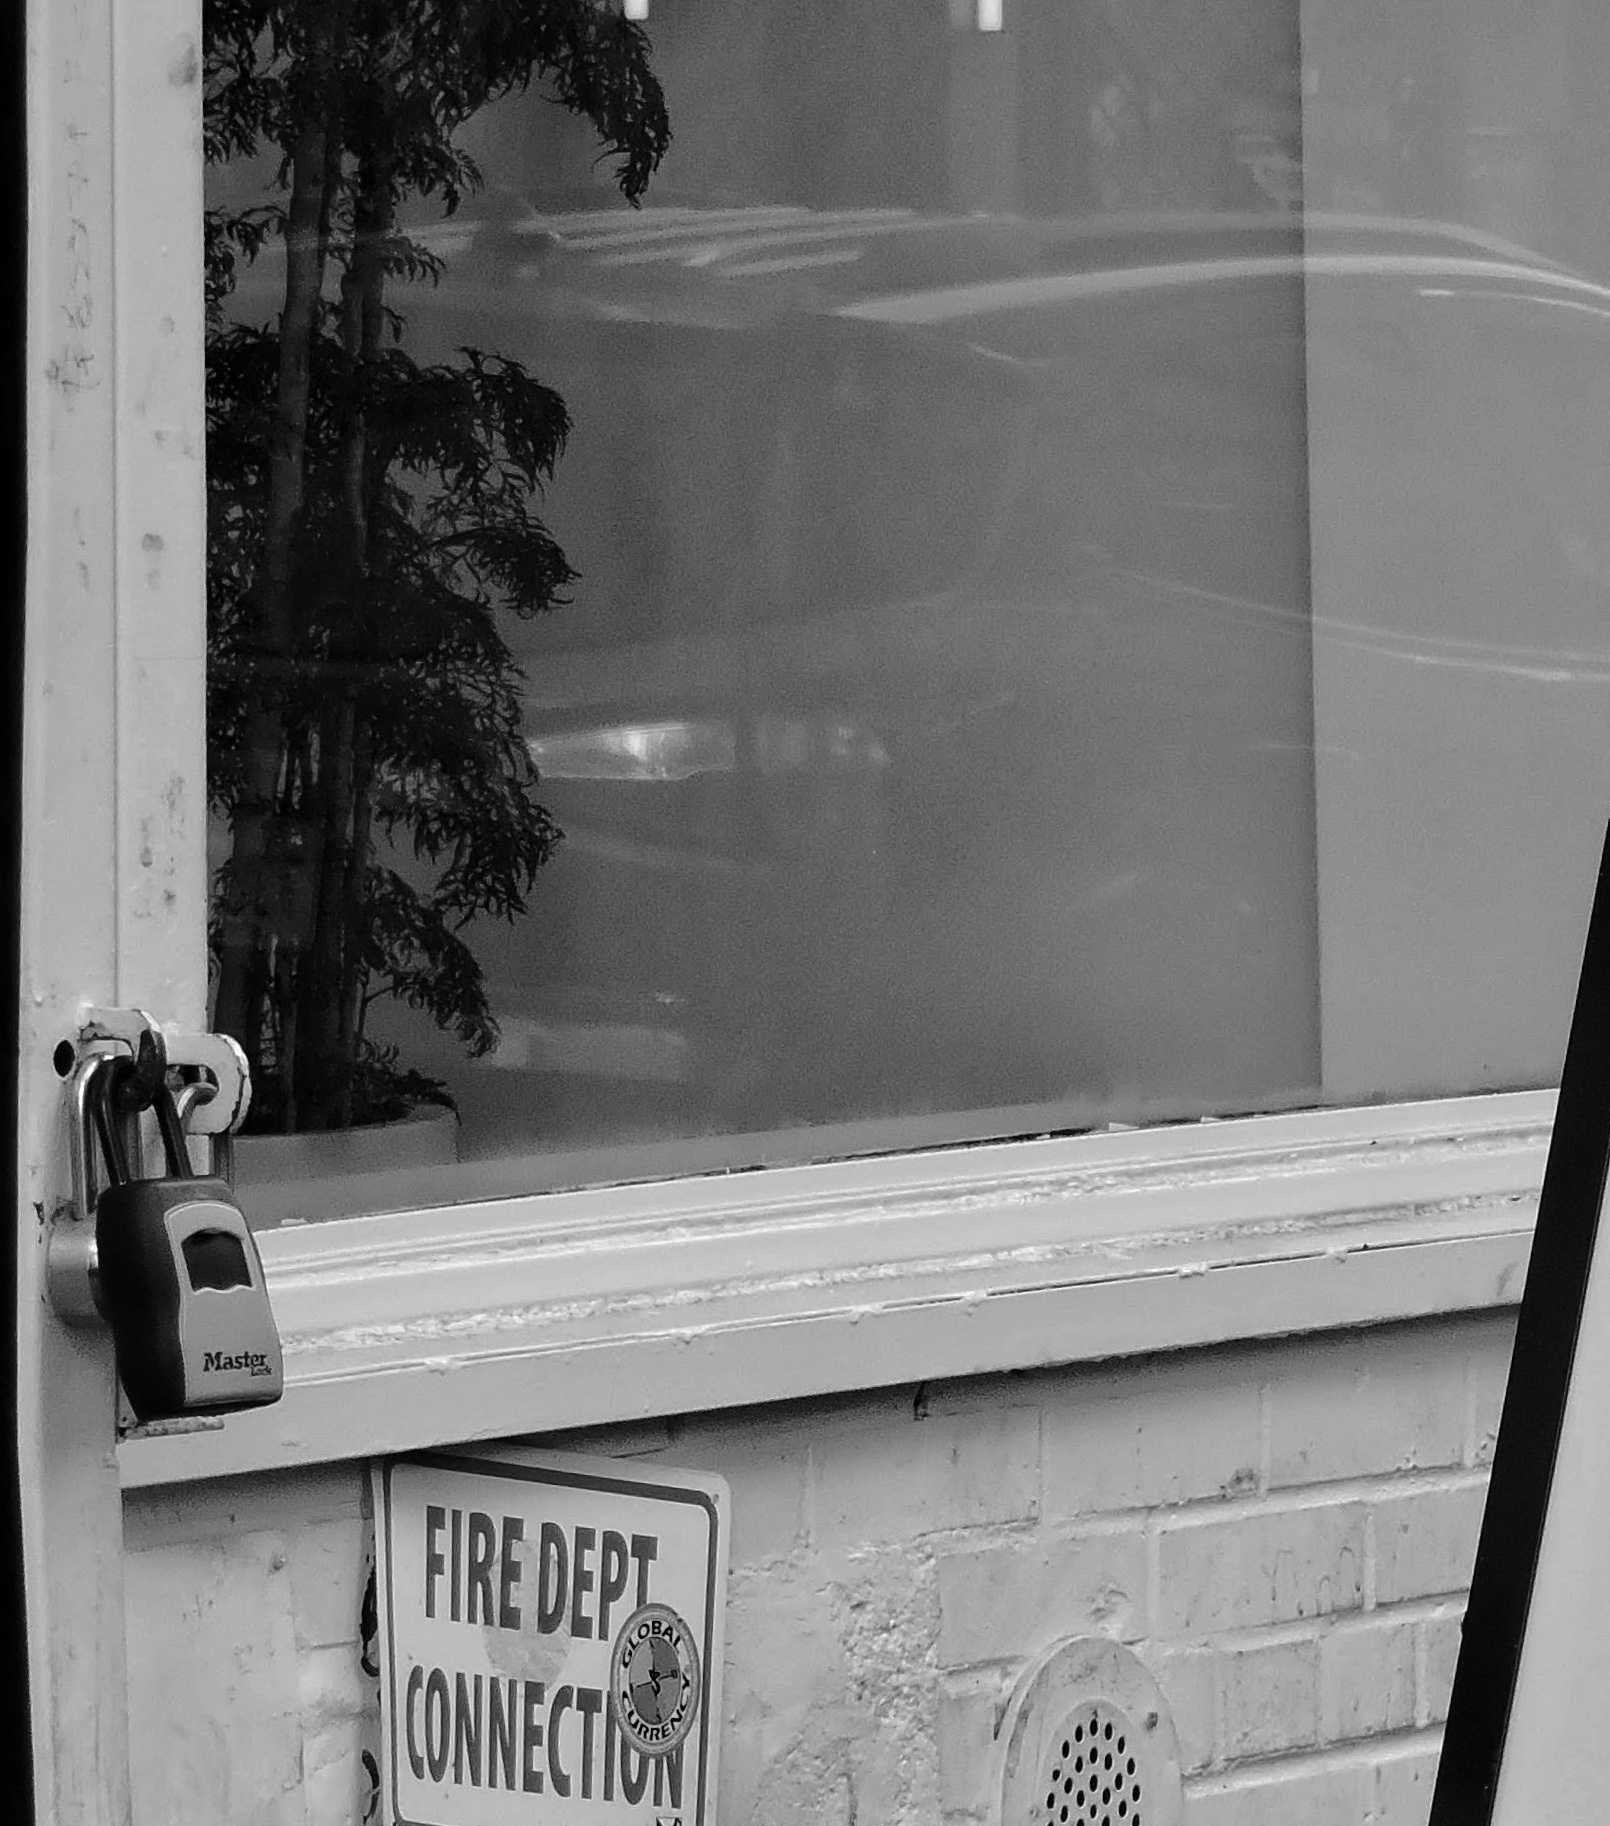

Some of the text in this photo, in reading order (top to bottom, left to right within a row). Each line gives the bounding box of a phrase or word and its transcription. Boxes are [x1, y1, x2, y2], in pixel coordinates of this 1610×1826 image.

[202, 1351, 267, 1372] Master
[424, 1504, 660, 1642] FIRE DEPT
[621, 1620, 681, 1669] GLOBAL
[621, 1671, 691, 1742] CURRENCY
